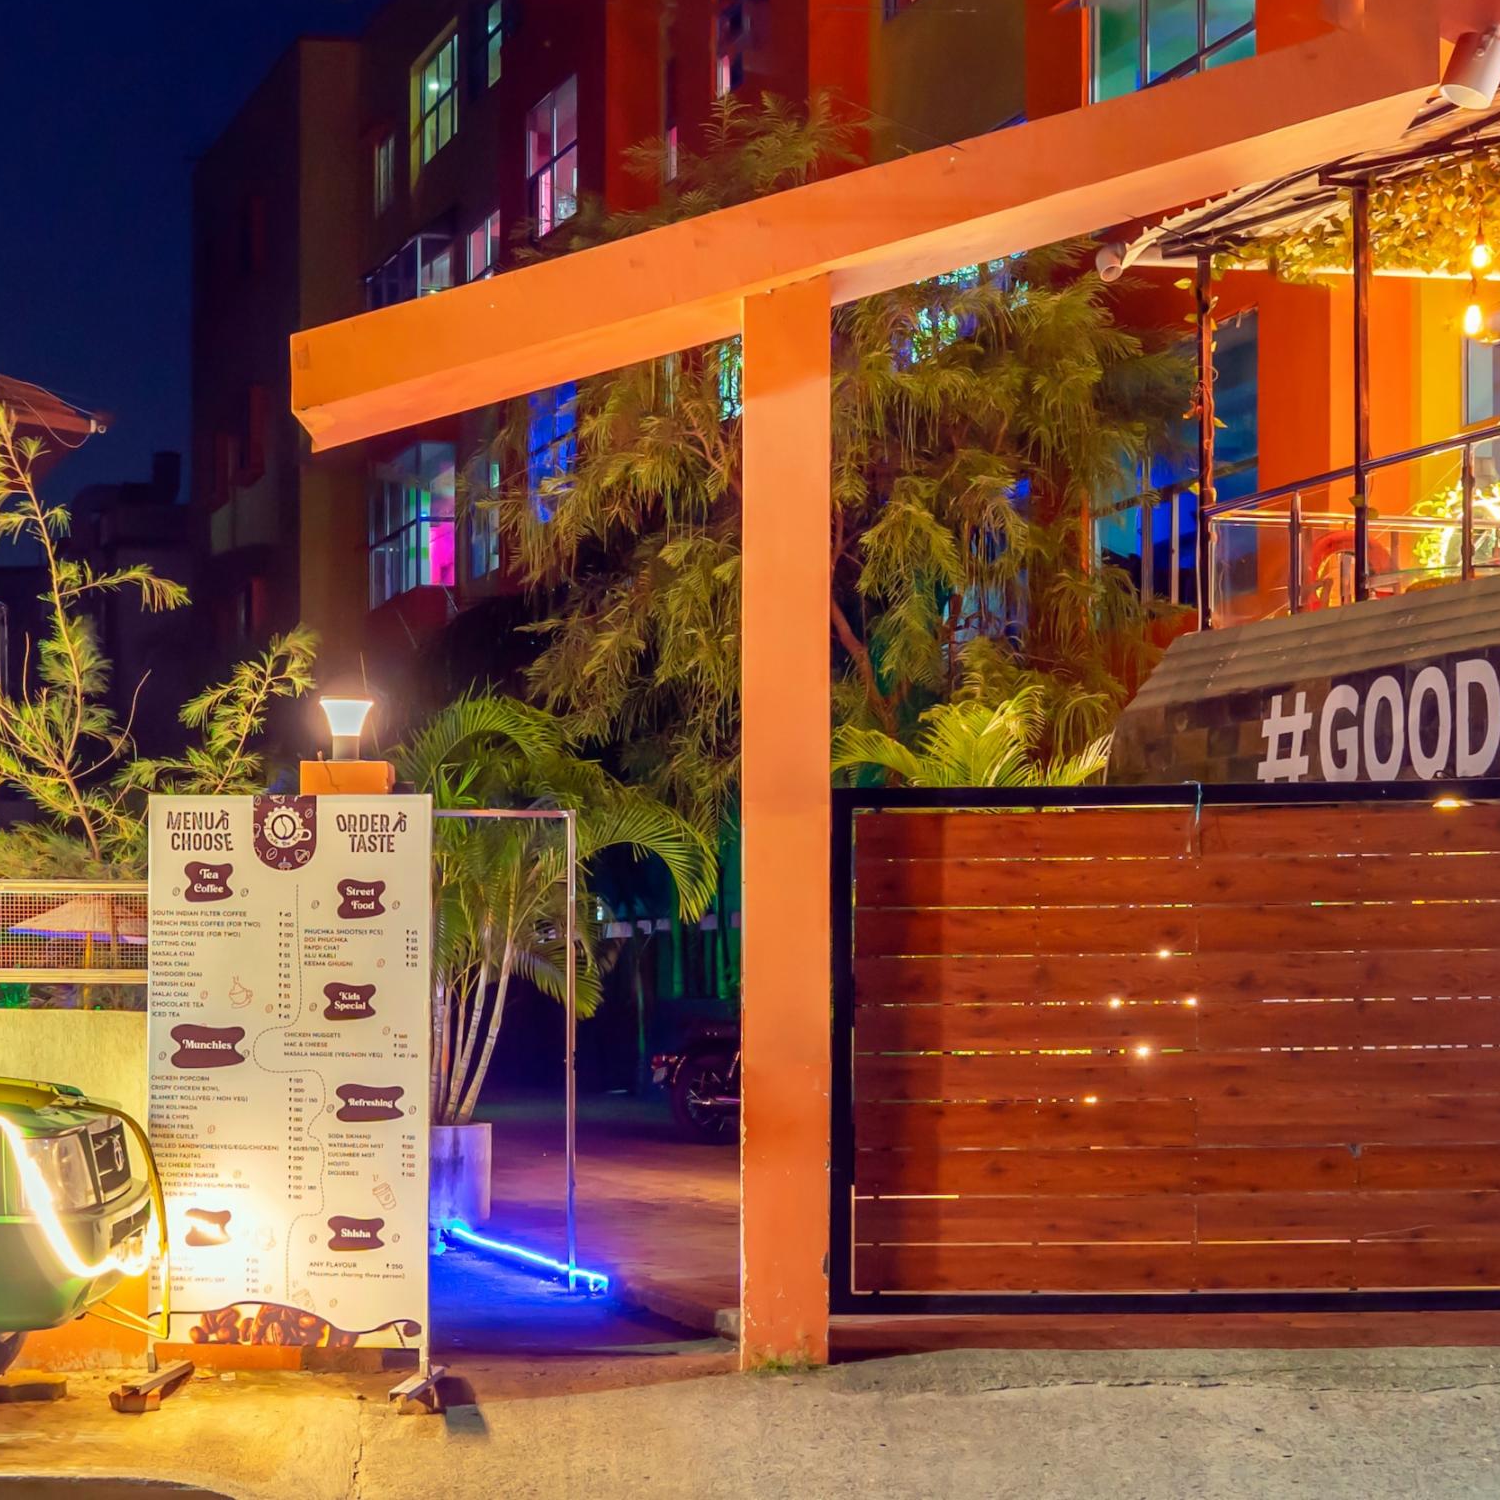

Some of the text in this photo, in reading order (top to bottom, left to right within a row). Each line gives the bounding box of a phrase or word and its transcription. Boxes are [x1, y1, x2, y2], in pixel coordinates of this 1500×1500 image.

[167, 811, 214, 830] MENU
[336, 814, 390, 832] ORDER
[171, 833, 234, 851] CHOOSE
[349, 834, 395, 852] TASTE
[199, 868, 219, 880] Tea
[194, 884, 224, 894] Coffee
[346, 886, 374, 896] Street
[351, 900, 374, 910] Food
[339, 992, 361, 1000] Kids
[334, 1001, 366, 1011] Special
[182, 1039, 232, 1050] Munchies
[348, 1098, 393, 1108] Refreshing
[341, 1228, 371, 1238] Shisha
